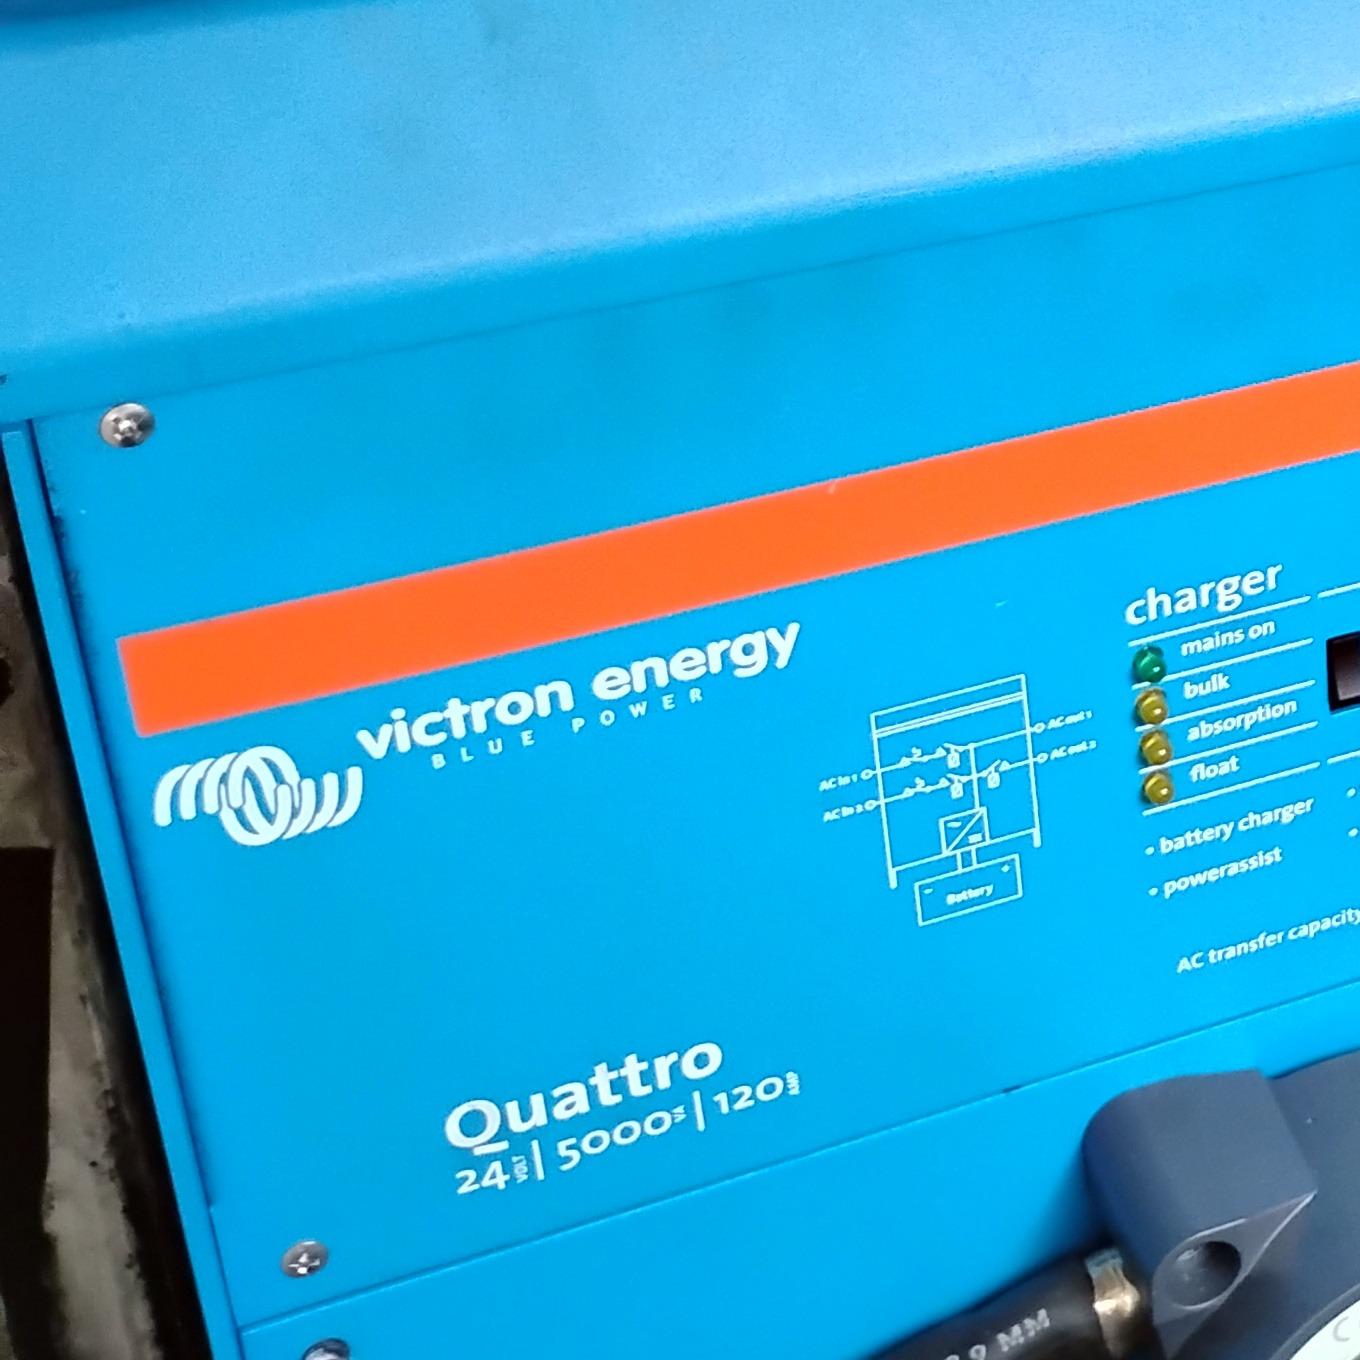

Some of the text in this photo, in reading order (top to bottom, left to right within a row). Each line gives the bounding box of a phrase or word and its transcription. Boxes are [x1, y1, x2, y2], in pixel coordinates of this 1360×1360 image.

[1124, 563, 1283, 626] charger
[1181, 620, 1276, 657] mains on
[356, 621, 801, 760] victron energy
[1183, 673, 1231, 700] bulk
[431, 687, 704, 770] BLUE POWER
[1187, 699, 1297, 742] absorption
[1189, 754, 1241, 784] float
[1159, 797, 1315, 855] battery charger
[1163, 845, 1283, 900] powerassist
[1176, 952, 1206, 975] AC
[1208, 929, 1285, 966] transfer
[444, 1041, 724, 1156] Quattro
[455, 1160, 510, 1194] 24
[556, 1110, 672, 1172] 5000
[713, 1076, 784, 1115] 120
